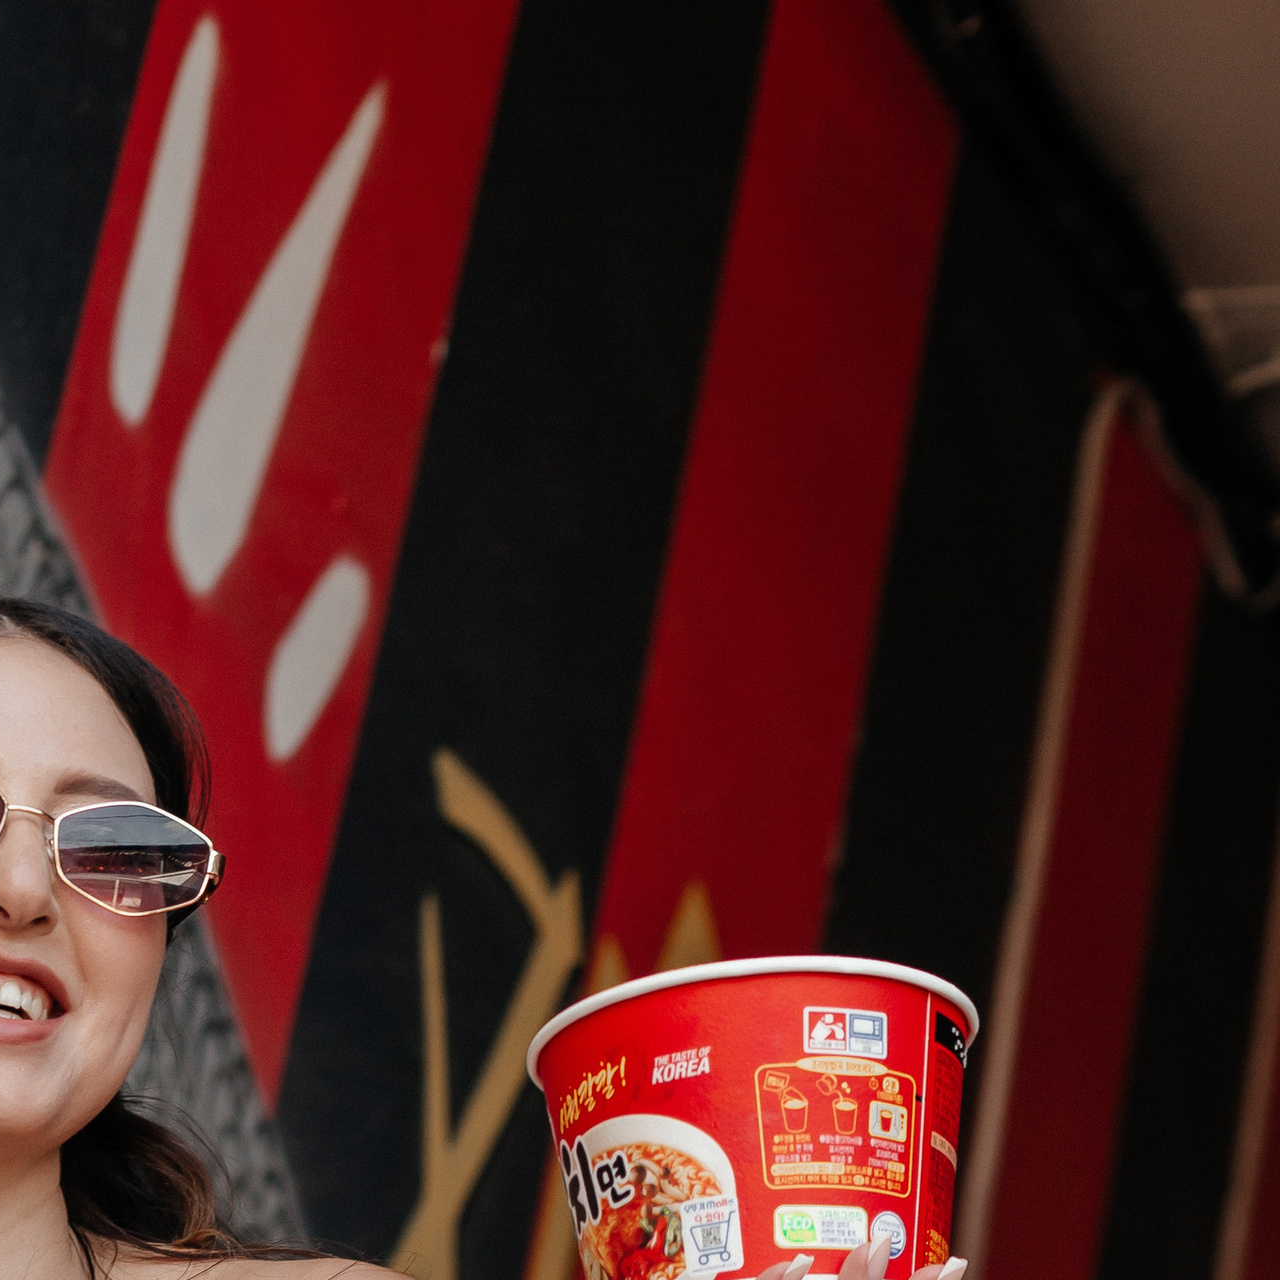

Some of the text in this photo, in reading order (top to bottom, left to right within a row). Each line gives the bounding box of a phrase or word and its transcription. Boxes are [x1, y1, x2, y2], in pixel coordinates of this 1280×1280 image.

[654, 1046, 712, 1067] THE TASTE OF
[651, 1057, 711, 1085] KOREA
[782, 1214, 812, 1230] ECO
